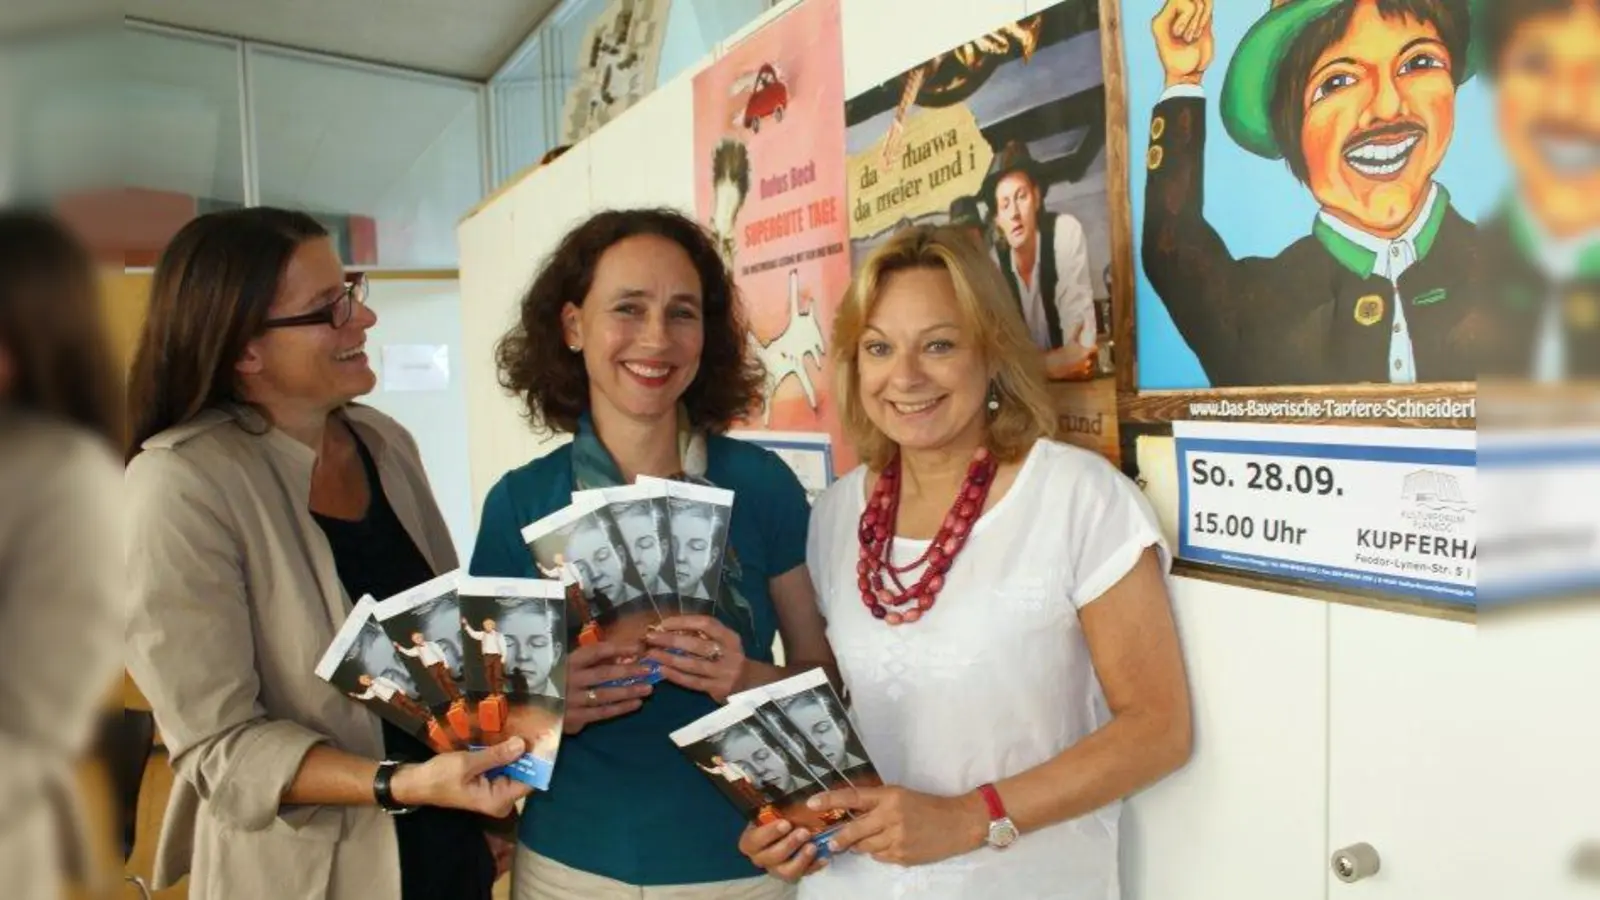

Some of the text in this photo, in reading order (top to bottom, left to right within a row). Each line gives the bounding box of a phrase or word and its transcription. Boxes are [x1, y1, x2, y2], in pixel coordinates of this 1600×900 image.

[853, 142, 976, 223] da meier und i
[860, 165, 878, 189] da
[807, 195, 838, 230] TAGE
[1192, 458, 1343, 496] So. 28.09.
[1194, 511, 1307, 545] 15.00 Uhr
[1455, 566, 1464, 577] 5
